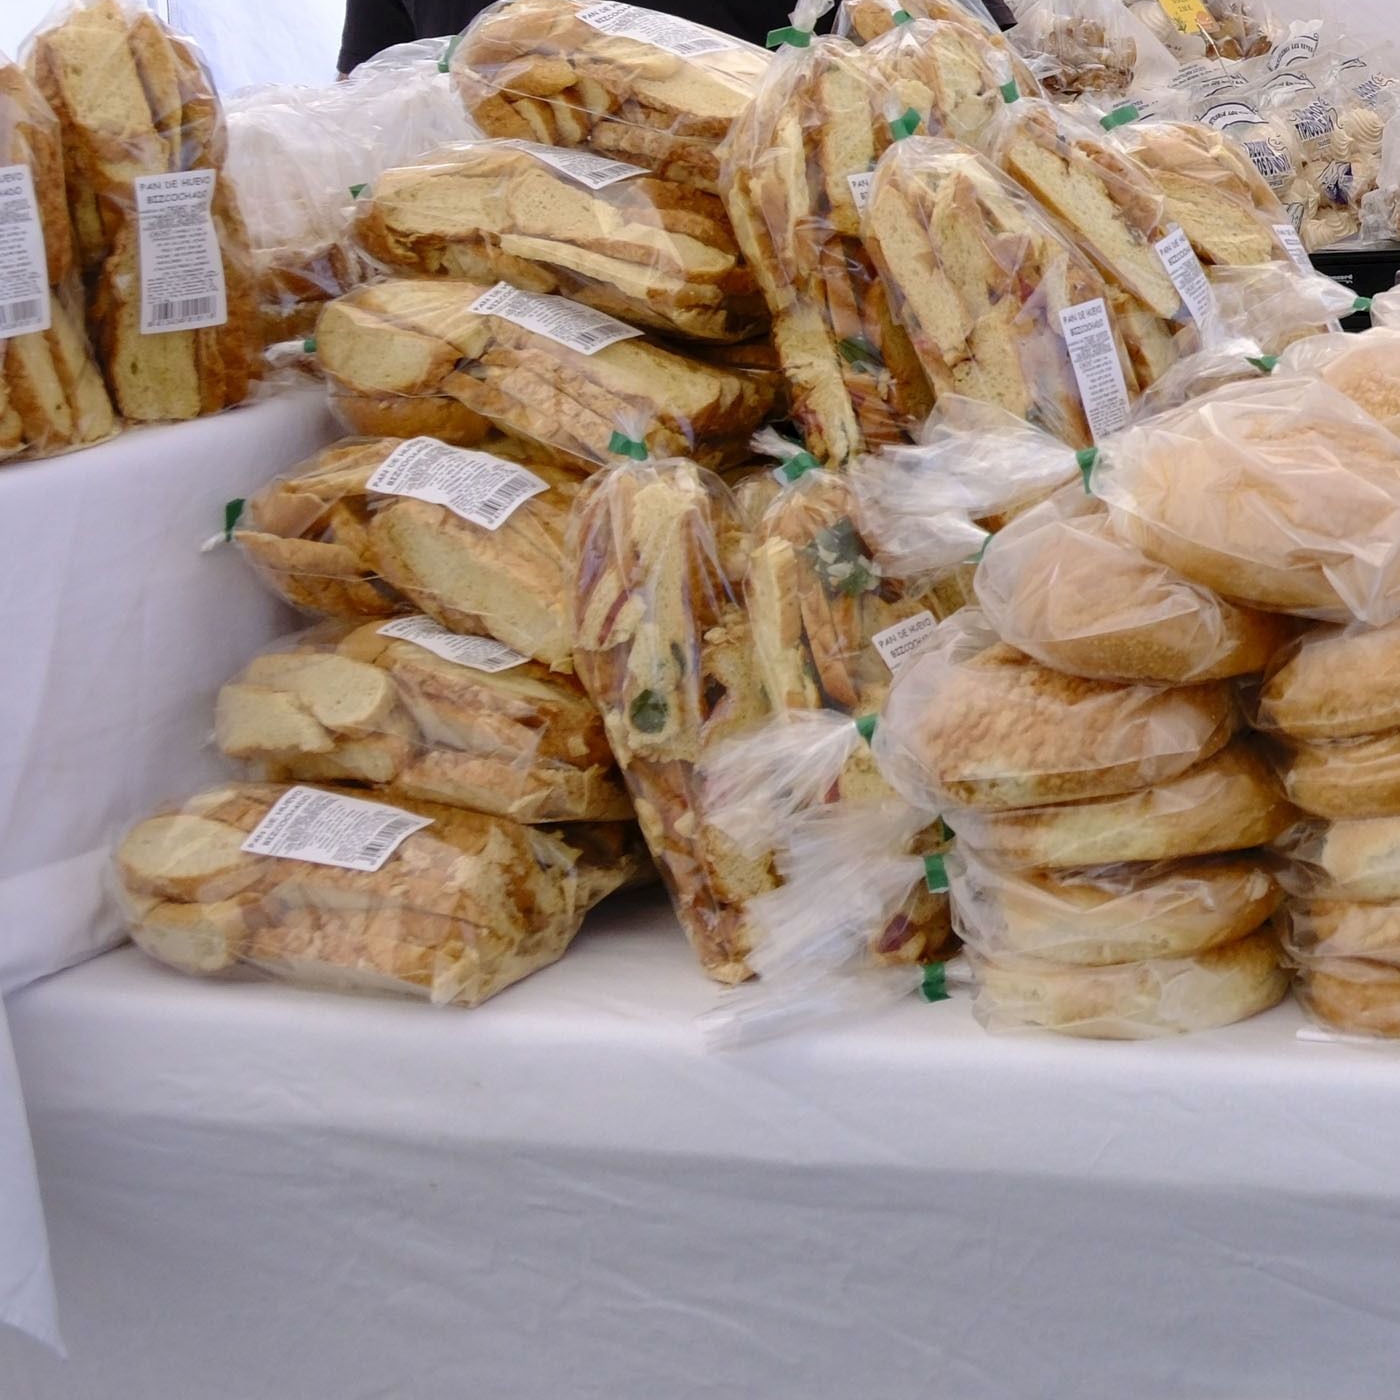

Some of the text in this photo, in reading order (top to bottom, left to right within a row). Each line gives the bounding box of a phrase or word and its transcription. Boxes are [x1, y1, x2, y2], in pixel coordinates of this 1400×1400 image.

[140, 176, 212, 191] PAN DE HUEVO
[372, 469, 389, 487] PAN
[878, 617, 932, 648] PAN DE HUEVO
[248, 831, 266, 849] PAN
